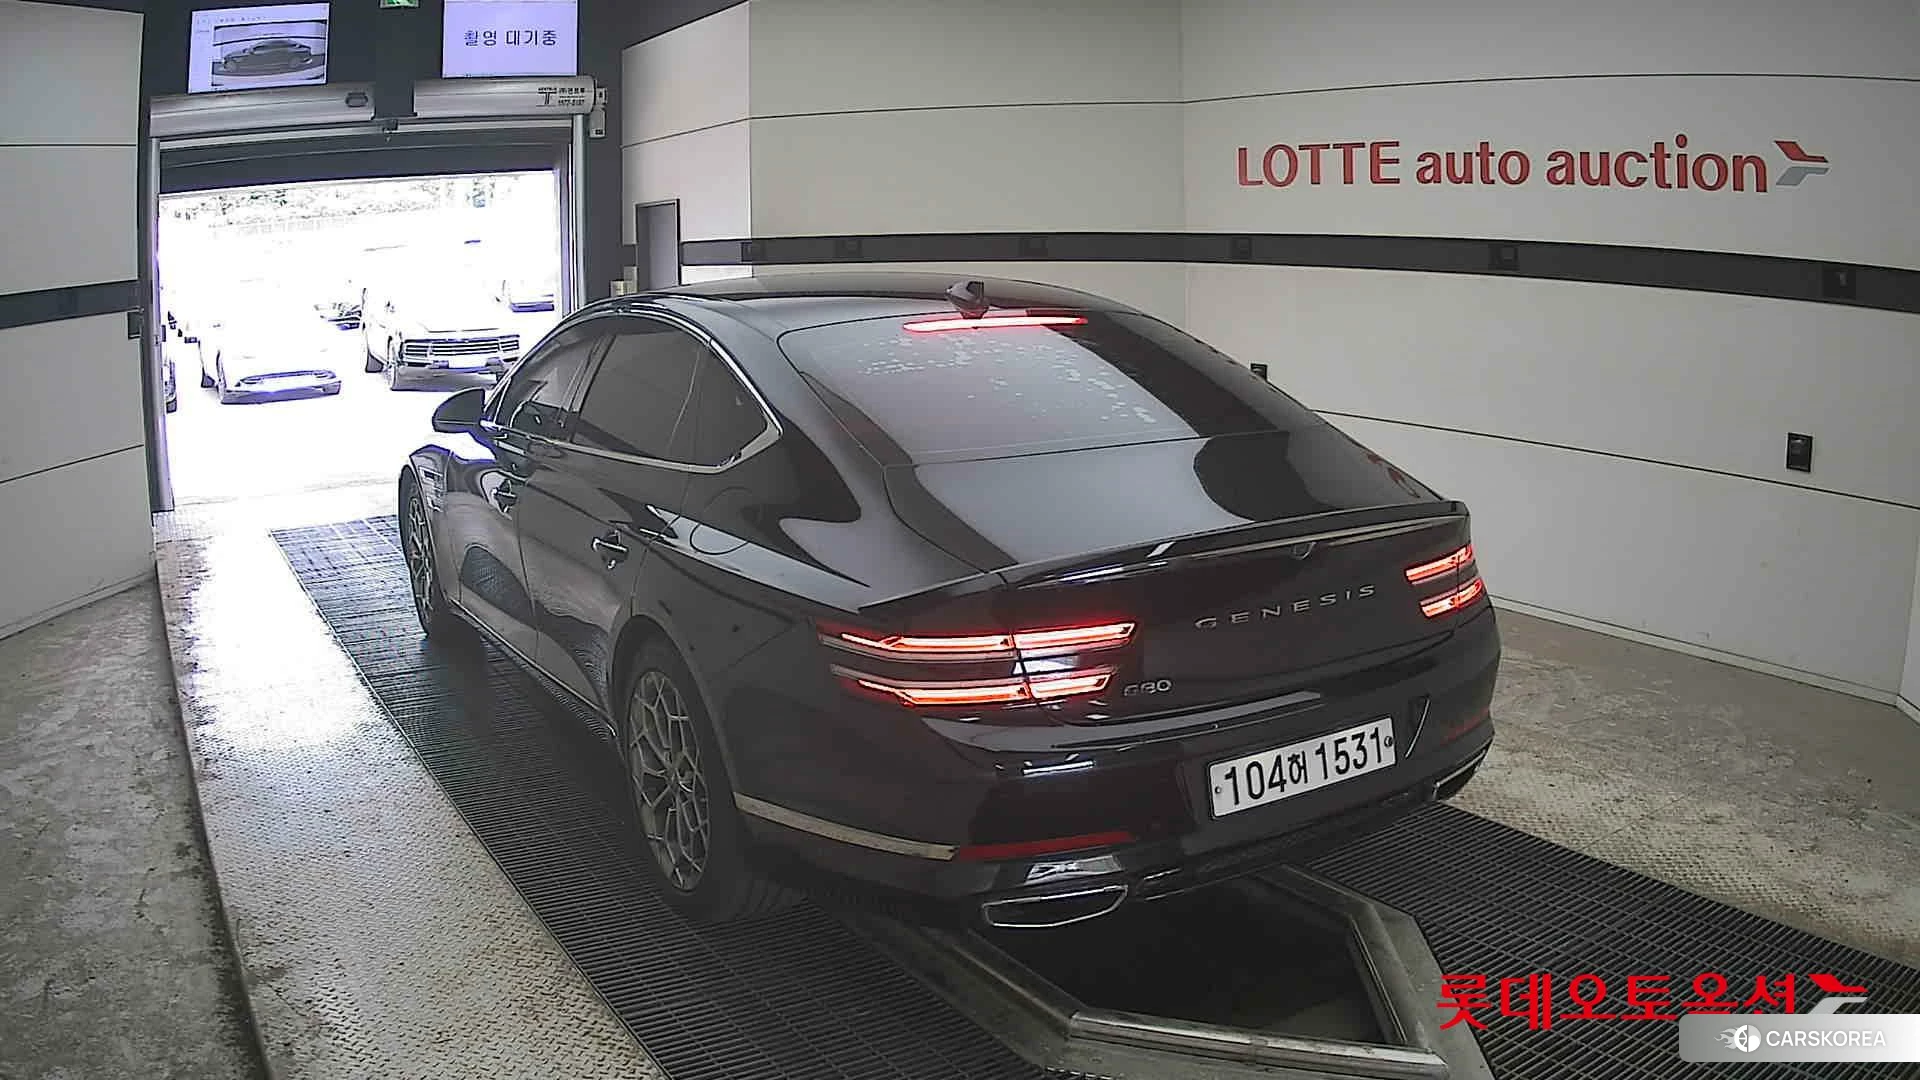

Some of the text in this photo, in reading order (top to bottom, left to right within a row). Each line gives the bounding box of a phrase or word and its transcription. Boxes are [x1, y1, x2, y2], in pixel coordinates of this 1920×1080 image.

[464, 29, 558, 47] 촬영 대기중
[1238, 133, 1768, 193] LOTTE auto auction
[1194, 584, 1376, 630] GENESIS
[1224, 727, 1382, 806] 104허 1531
